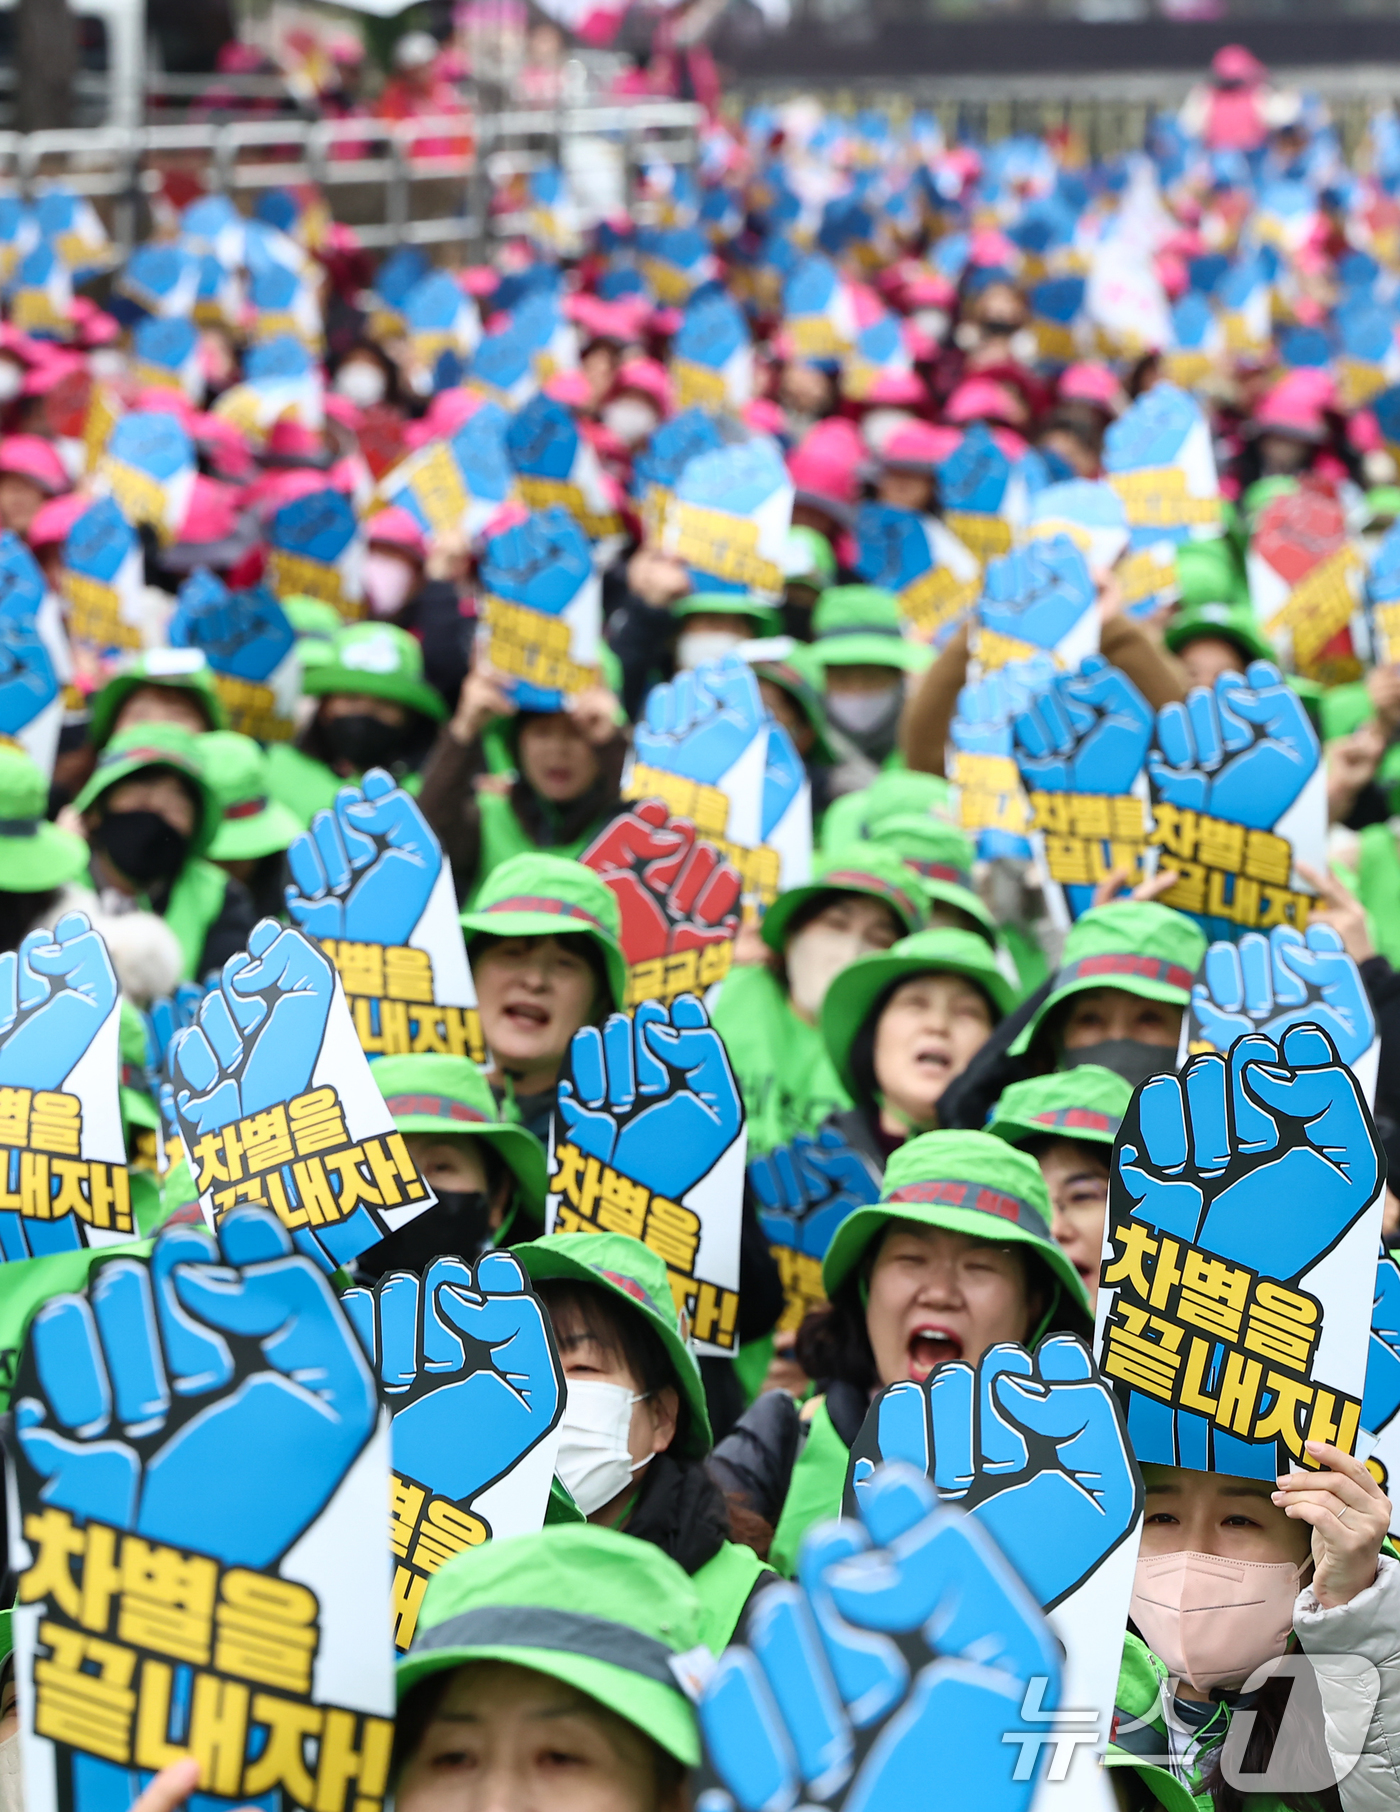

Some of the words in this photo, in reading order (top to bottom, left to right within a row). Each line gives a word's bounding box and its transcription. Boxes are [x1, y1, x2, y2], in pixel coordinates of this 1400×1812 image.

[1150, 802, 1291, 888] 차별을
[1158, 854, 1314, 932] 끝내자
[319, 938, 433, 1002] 별을
[346, 996, 486, 1062] 내자!
[0, 1087, 81, 1155] 별을
[193, 1088, 348, 1193] 차별을
[0, 1149, 132, 1231] 내자!
[550, 1143, 700, 1272] 차별을
[1105, 1223, 1318, 1373] 차별을
[20, 1511, 318, 1694] 차별을
[34, 1621, 395, 1812] 끝내자!
